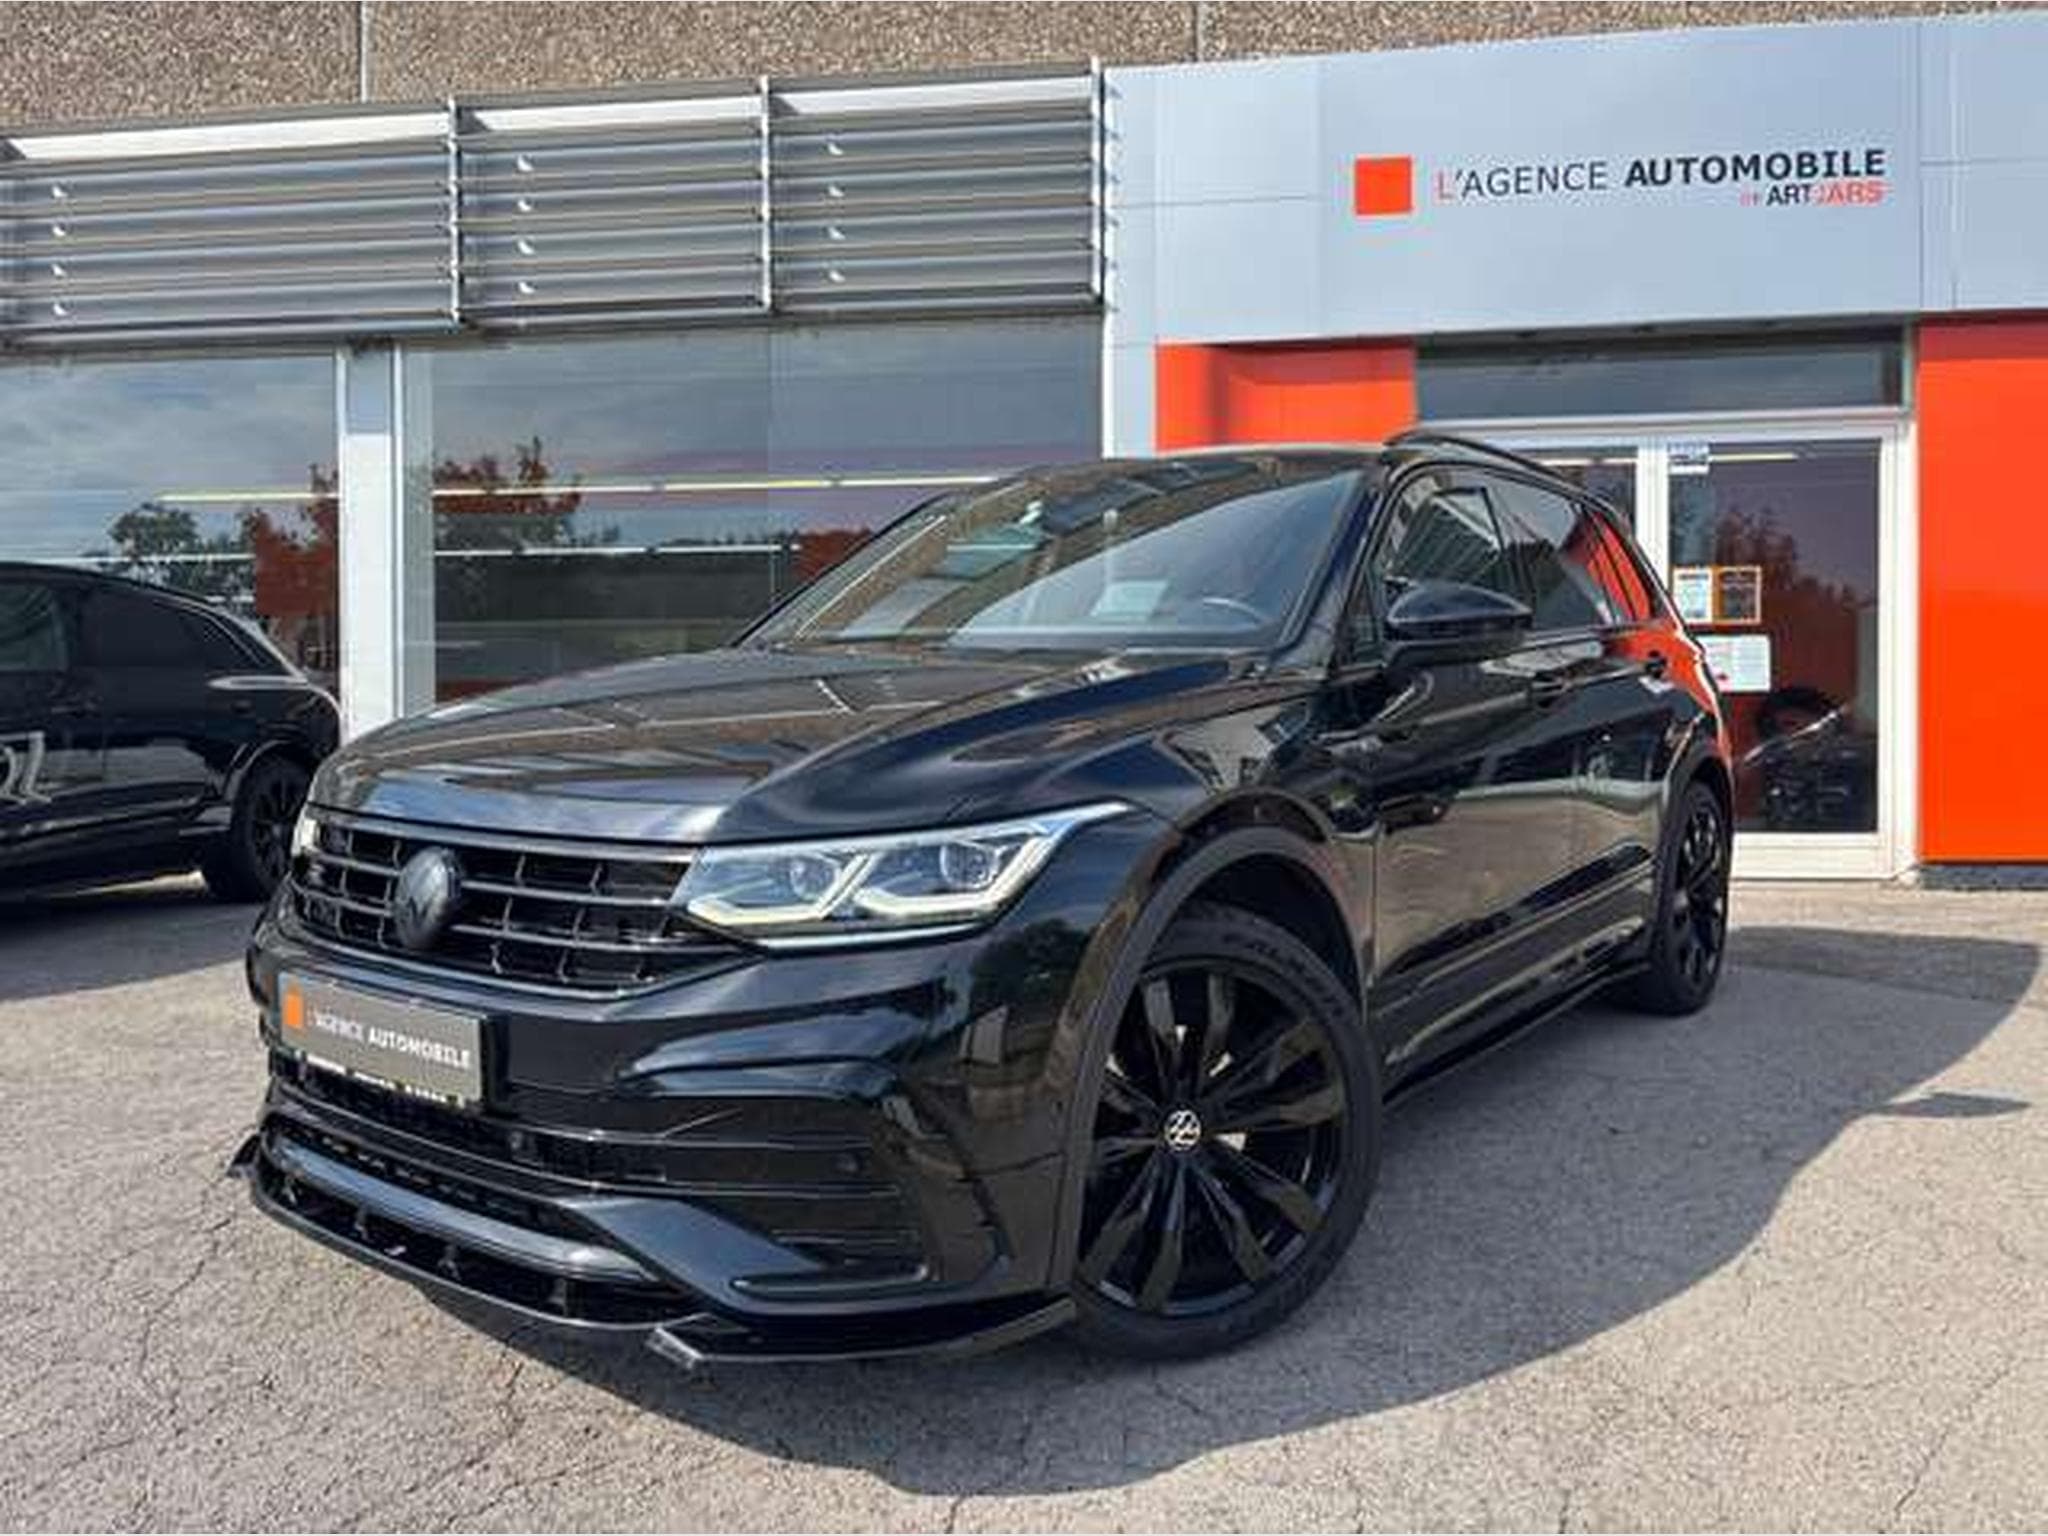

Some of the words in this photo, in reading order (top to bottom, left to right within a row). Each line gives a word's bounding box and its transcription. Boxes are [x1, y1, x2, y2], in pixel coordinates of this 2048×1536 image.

[1437, 162, 1608, 200] L'AGENCE
[1624, 149, 1886, 187] AUTOMOBILE
[368, 1027, 470, 1070] AUTOMOBILE
